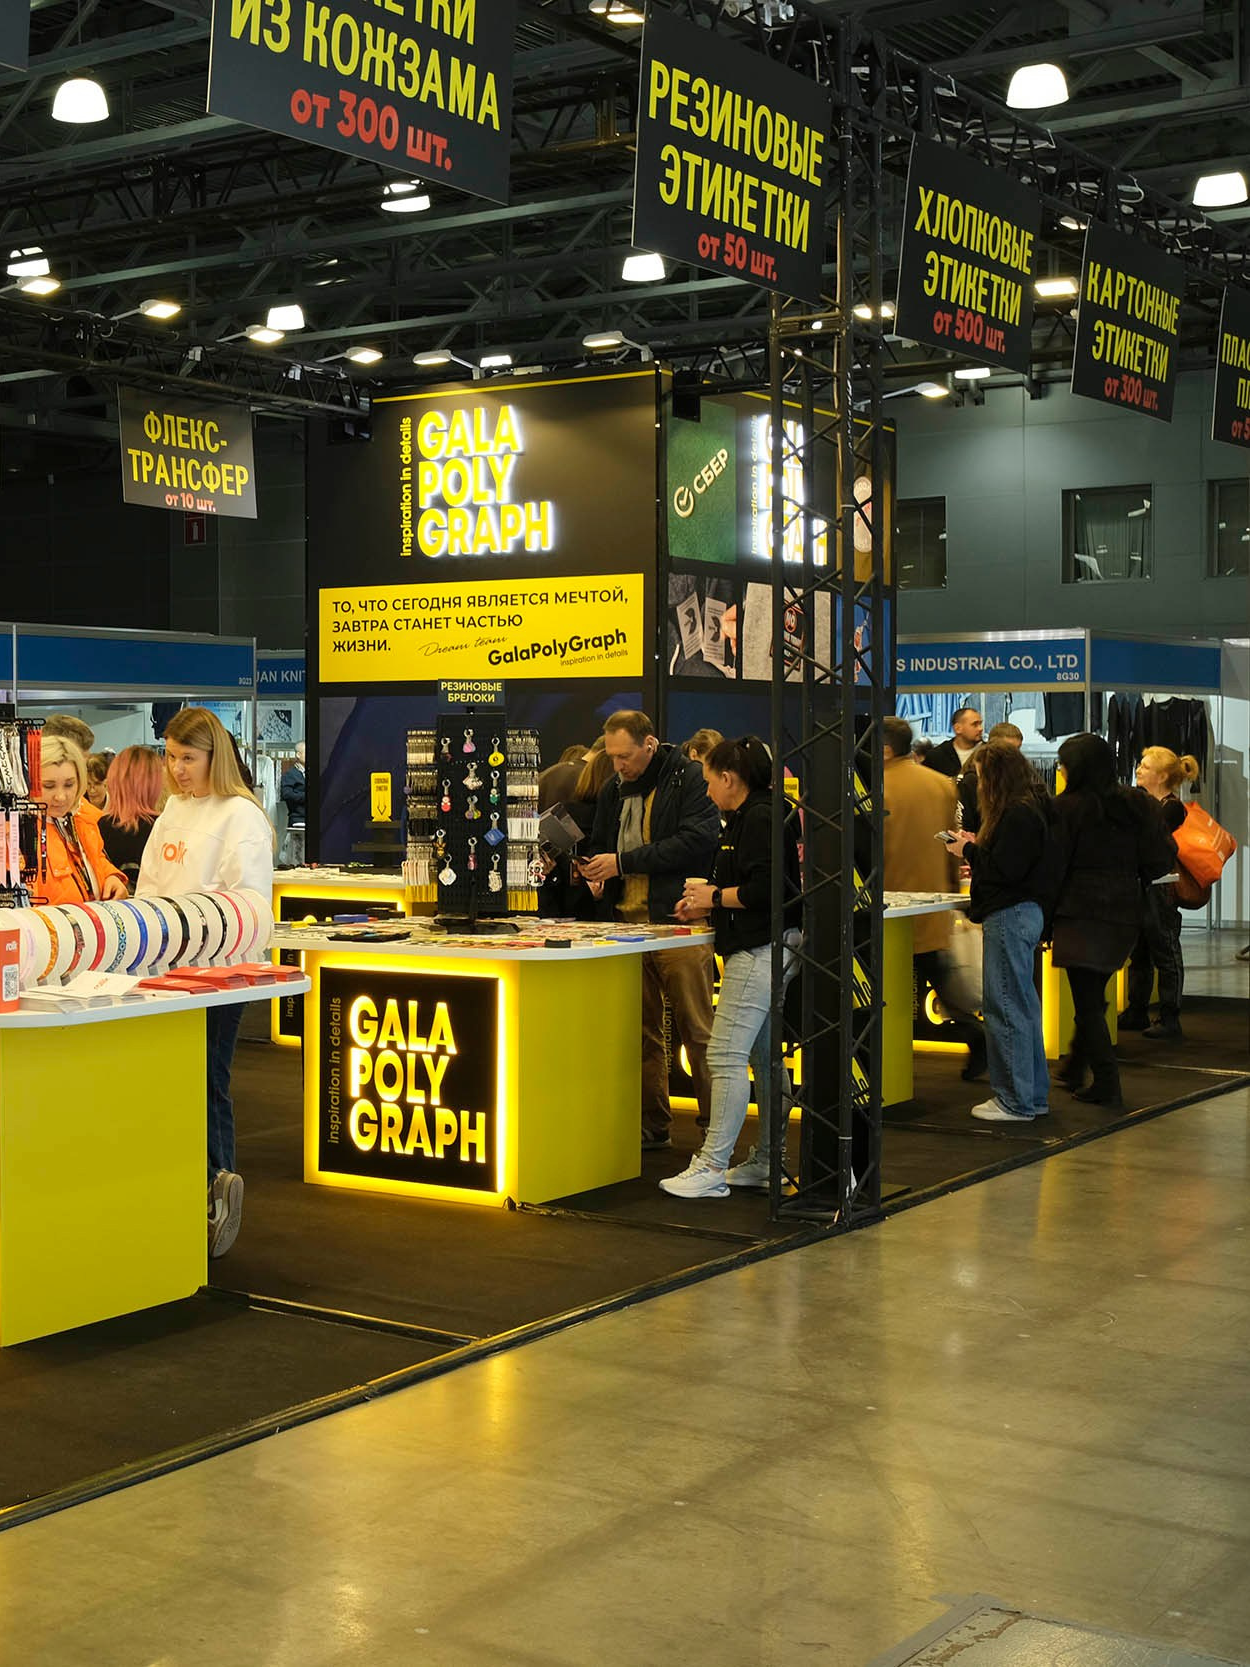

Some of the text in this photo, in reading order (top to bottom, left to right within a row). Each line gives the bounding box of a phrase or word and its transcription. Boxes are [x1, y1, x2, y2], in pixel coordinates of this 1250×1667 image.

[304, 1, 500, 131] КОЖЗАМА
[291, 89, 452, 171] от 300 шт.
[649, 59, 824, 187] РЕЗИНОВЫЕ
[659, 144, 810, 253] ЭТИКЕТКИ
[914, 186, 1034, 275] ХЛОПКОВЫЕ
[698, 232, 777, 281] от 50 шт.
[924, 250, 1022, 326] ЭТИКЕТКИ
[1087, 261, 1180, 336] КАРТОННЫЕ
[934, 309, 1006, 353] от 500 шт.
[1092, 320, 1170, 383] ЭТИКЕТКИ
[1104, 375, 1159, 410] от 300 шт.
[144, 410, 229, 454] ФЛЕКС-
[417, 404, 522, 460] GALA
[1232, 419, 1243, 438] от
[127, 447, 249, 497] ТРАНСФЕР
[400, 416, 412, 557] inspiration in details
[418, 454, 518, 508] POLY
[693, 448, 729, 495] СБЕР
[165, 492, 216, 512] от 10 шт.
[417, 501, 554, 558] GRAPH
[332, 614, 523, 633] ЗАВТРА СТАНЕТ ЧАСТЬЮ
[333, 586, 628, 614] ТО, ЧТО СЕГОДНЯ ЯВЛЯЕТСЯ МЕЧТОЙ,
[332, 639, 391, 653] ЖИЗНИ.
[418, 636, 508, 657] Dream team
[488, 628, 627, 666] GalaPolyGraph
[560, 649, 628, 667] inspiration in details
[910, 655, 1005, 672] INDUSTRIAL
[1009, 654, 1042, 671] CO.,
[1047, 654, 1078, 669] LTD
[441, 681, 502, 692] РЕЗИНОВЫЕ
[447, 693, 495, 703] БРЕЛОКИ
[1056, 672, 1079, 681] 8G30
[350, 994, 458, 1056] GALA
[327, 997, 342, 1144] inspiration in details
[350, 1046, 450, 1105] POLY
[350, 1098, 487, 1164] GRAPH
